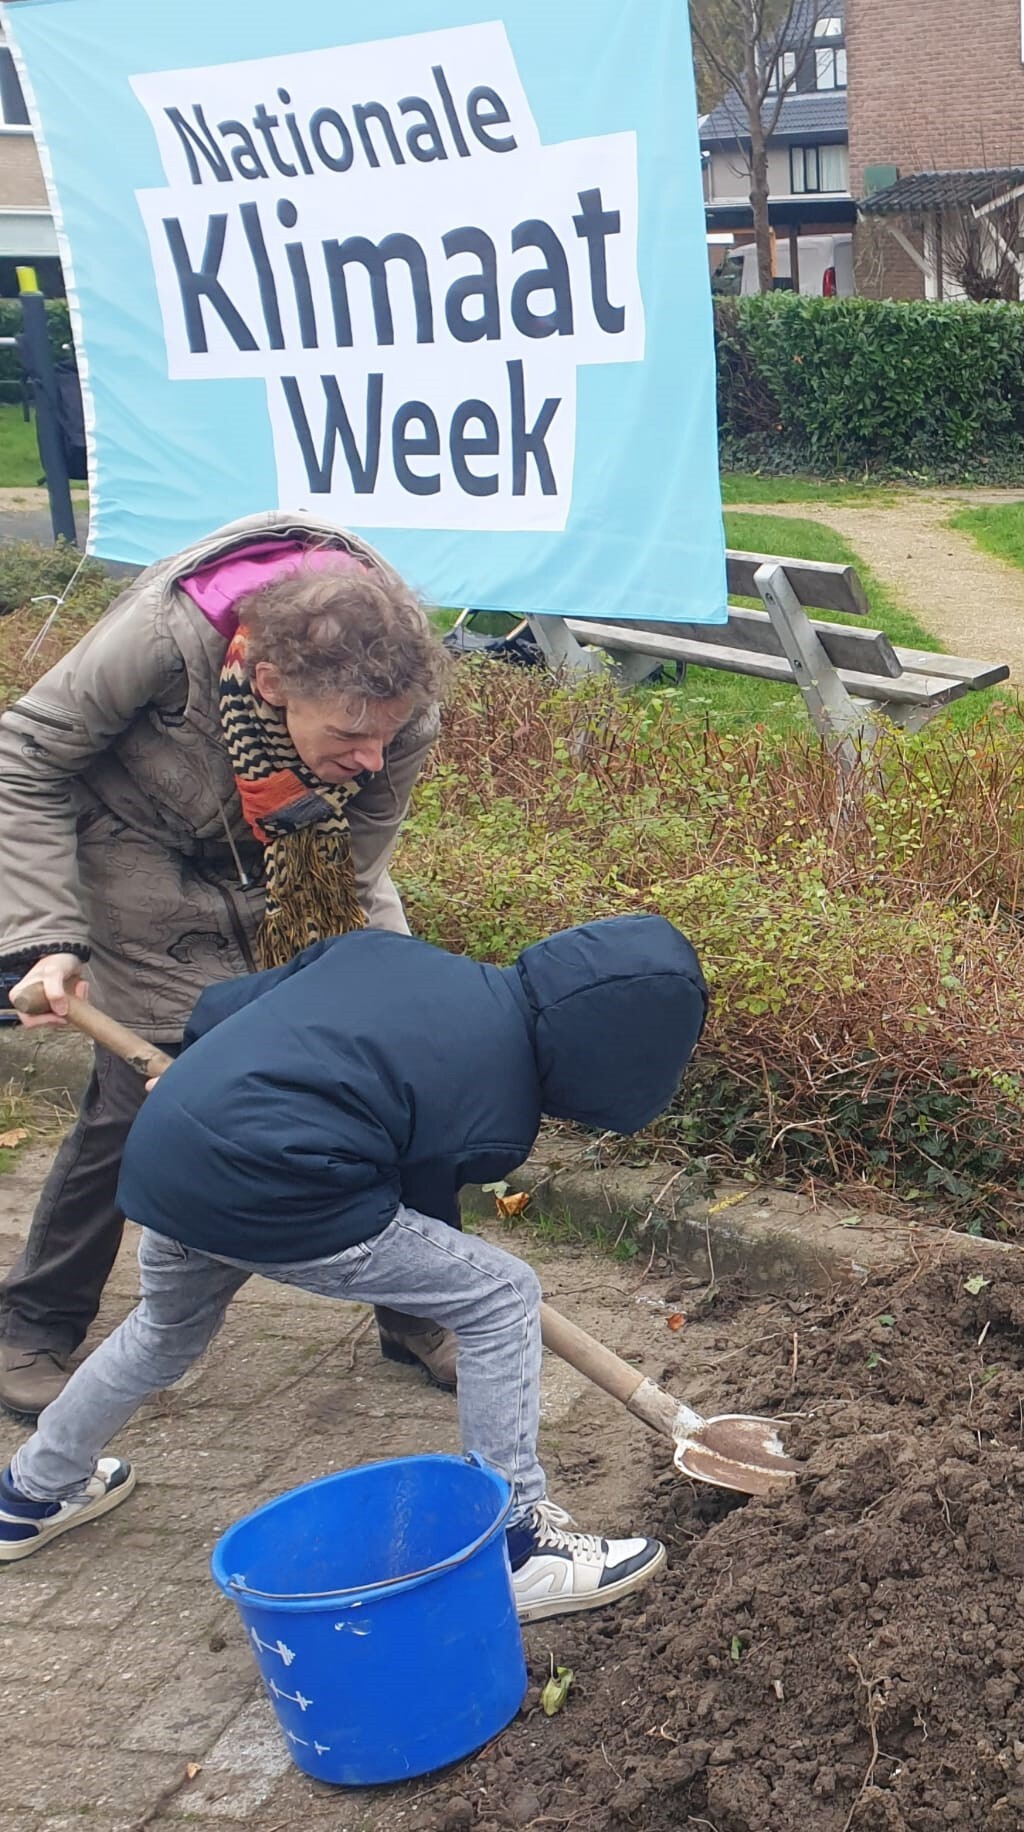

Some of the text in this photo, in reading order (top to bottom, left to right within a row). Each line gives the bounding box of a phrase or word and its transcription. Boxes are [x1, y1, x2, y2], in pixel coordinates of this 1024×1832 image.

[163, 65, 519, 185] Nationale
[162, 187, 626, 354] Klimaat
[280, 358, 563, 497] Week
